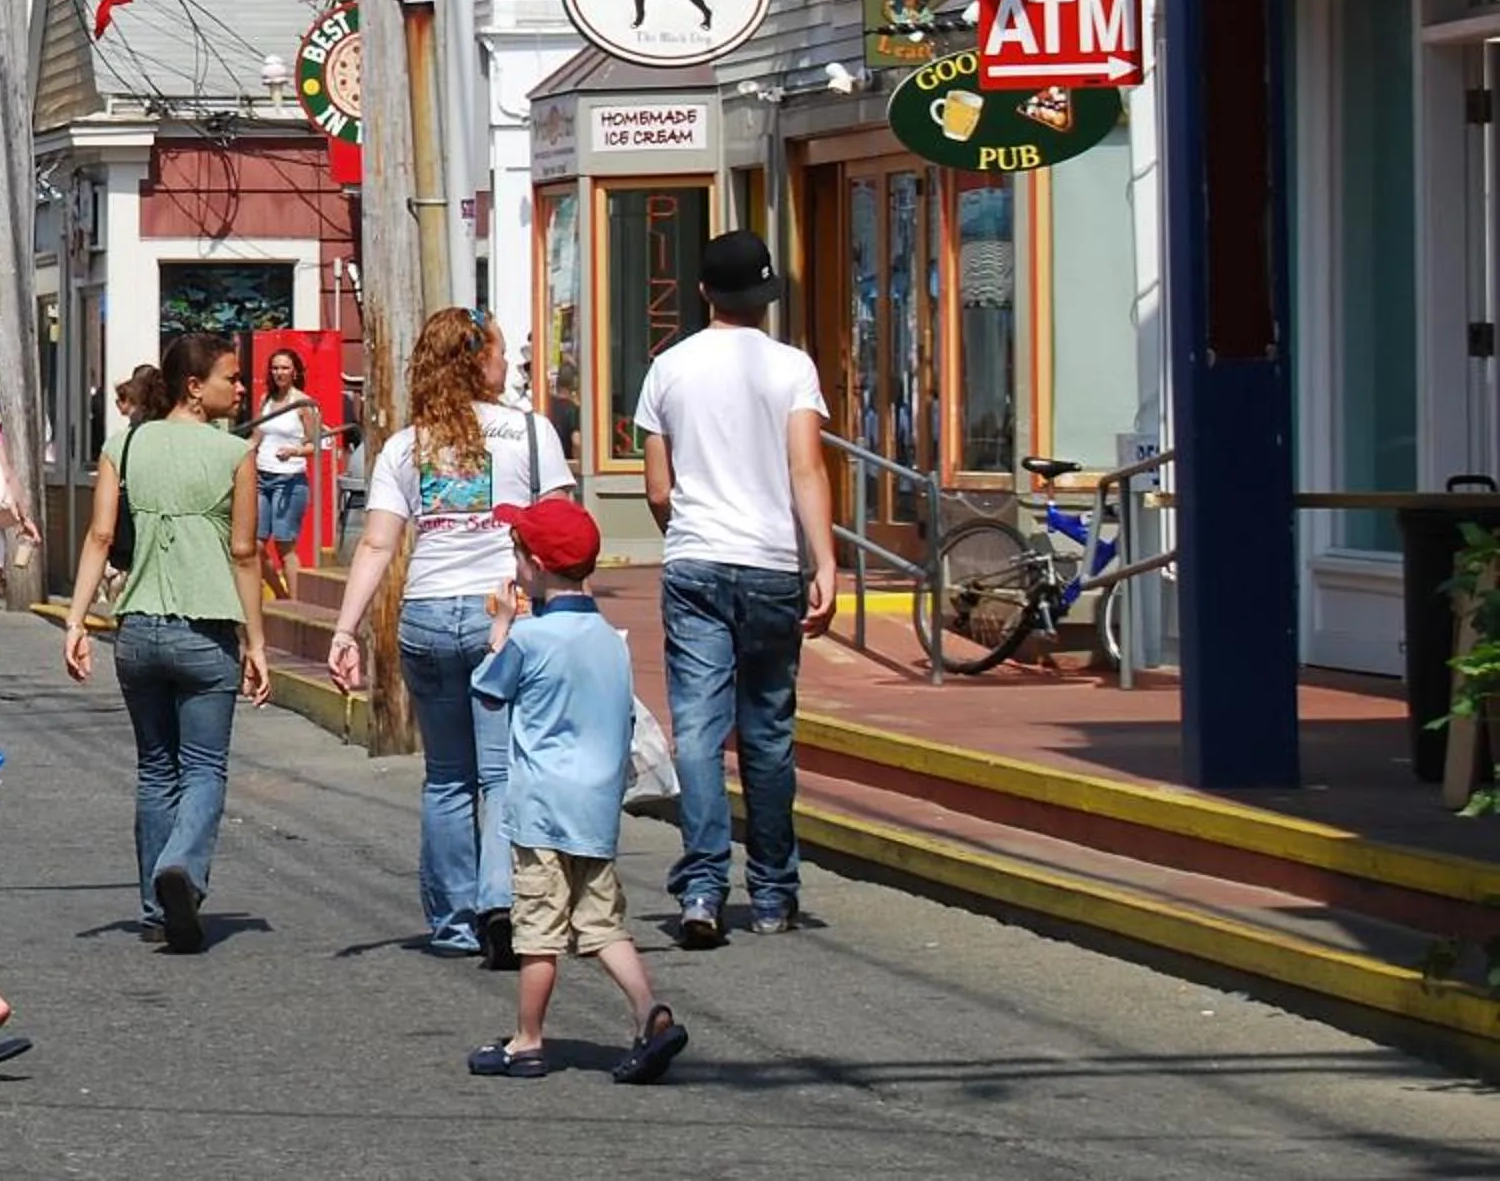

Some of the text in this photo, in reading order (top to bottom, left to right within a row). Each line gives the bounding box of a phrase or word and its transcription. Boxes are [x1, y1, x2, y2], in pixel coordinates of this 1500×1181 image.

[302, 11, 350, 64] BEST
[915, 51, 979, 90] GOO
[315, 105, 348, 136] IN
[601, 109, 697, 126] HOMEMADE
[604, 129, 693, 146] ICE CREAM
[979, 144, 1041, 170] PUB
[647, 195, 680, 359] PIZZ
